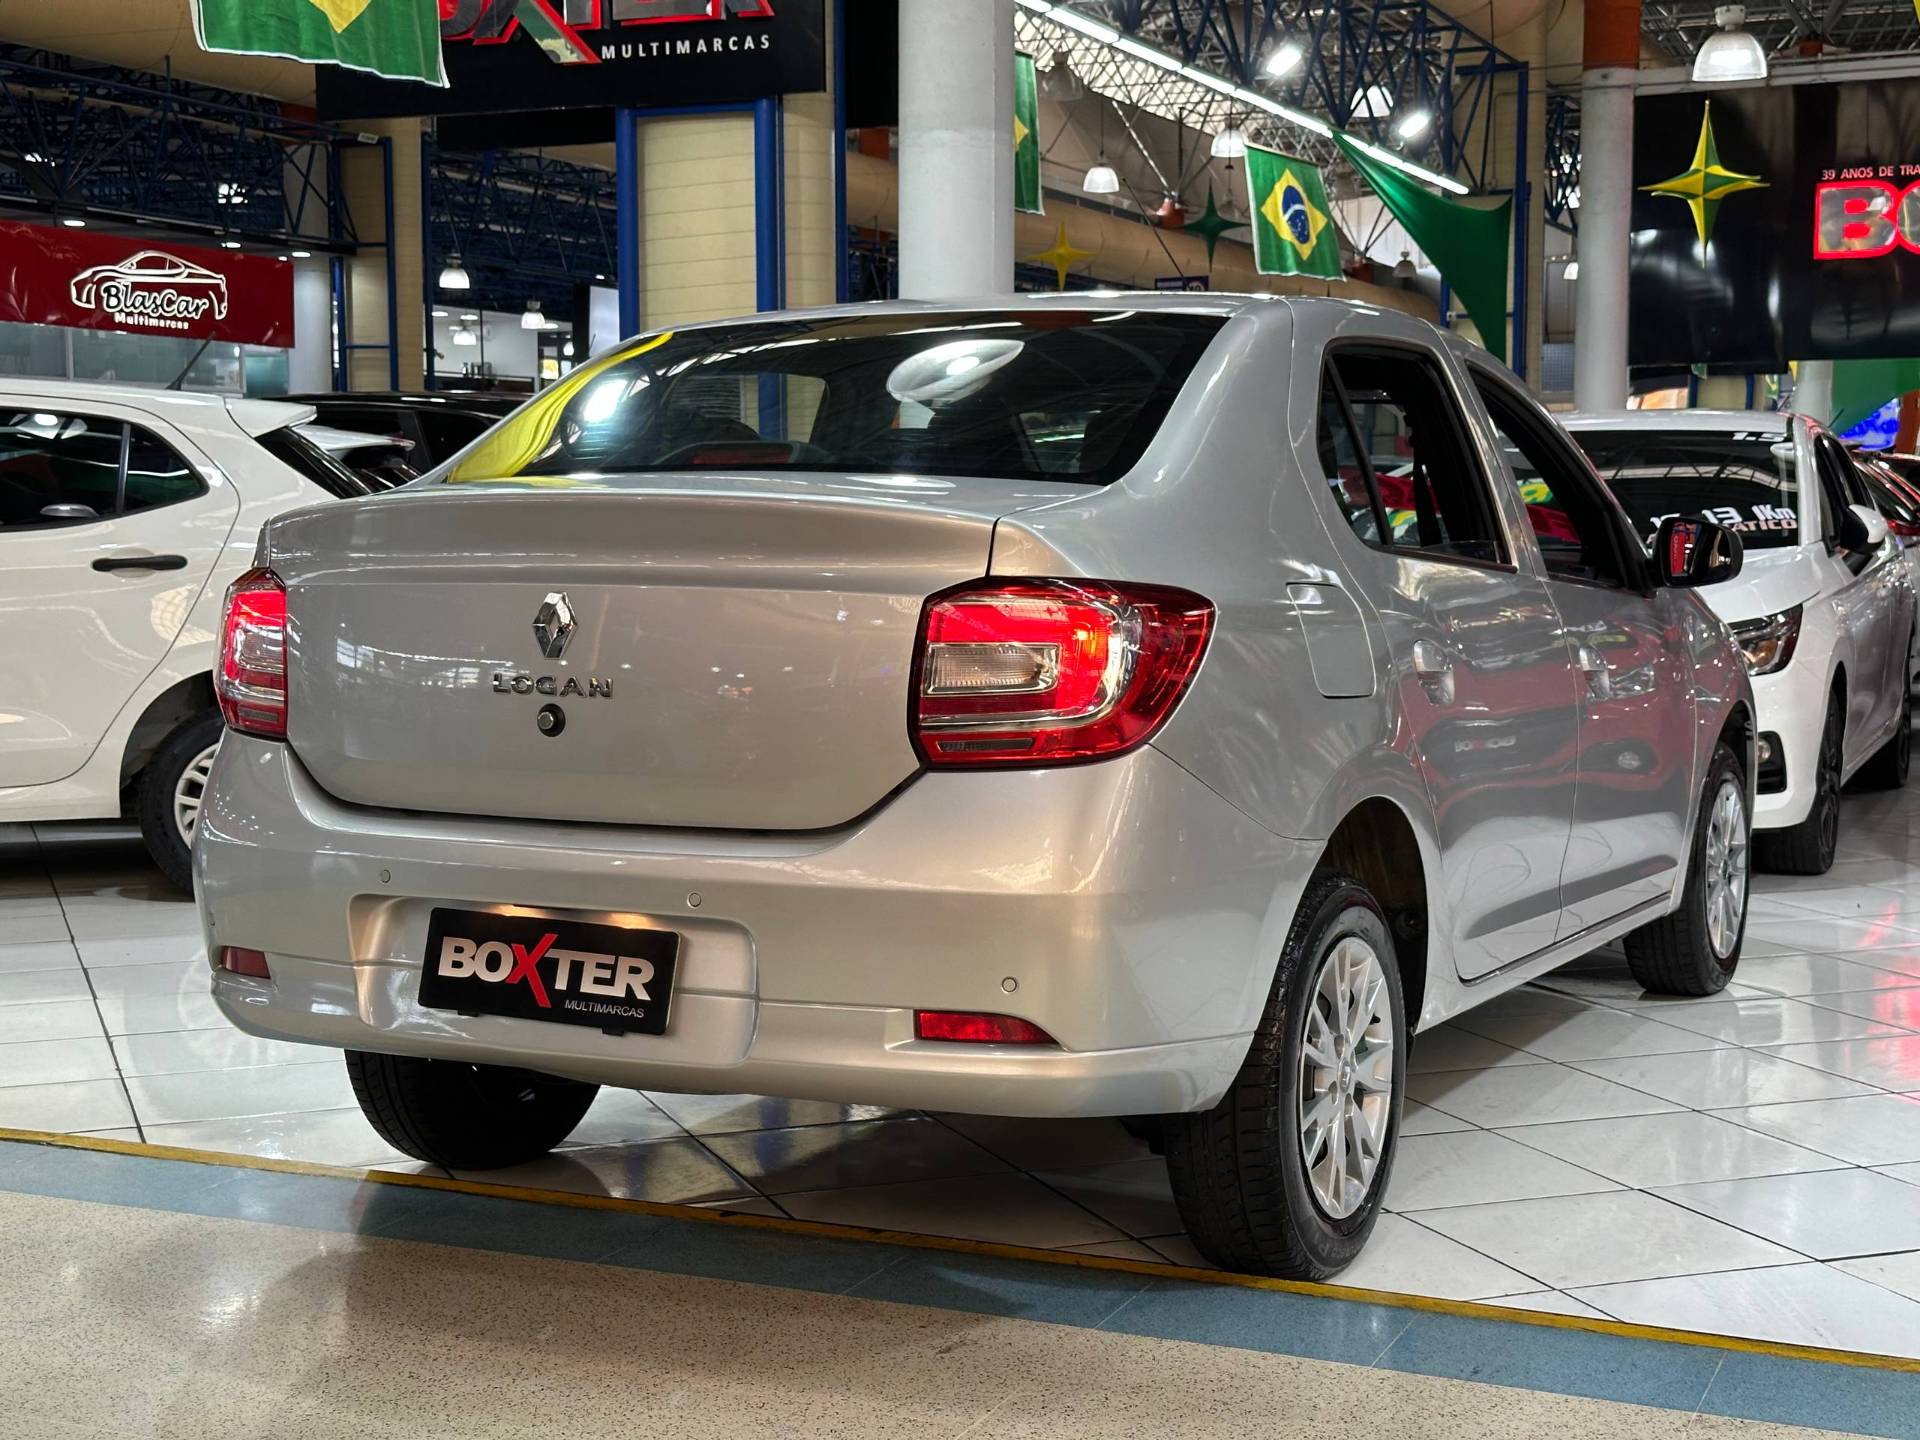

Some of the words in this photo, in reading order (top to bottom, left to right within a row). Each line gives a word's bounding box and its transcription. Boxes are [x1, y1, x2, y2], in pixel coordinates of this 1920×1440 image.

[601, 35, 770, 60] MULTIMARCAS
[1822, 169, 1836, 180] 39
[1840, 167, 1874, 179] ANOS
[1879, 166, 1894, 177] DE
[101, 281, 209, 319] BlasCar
[114, 312, 189, 329] Multimarcas
[493, 673, 614, 698] LOGAN
[438, 933, 655, 1008] BOXTER
[565, 1000, 645, 1018] MULTIMARCAS
